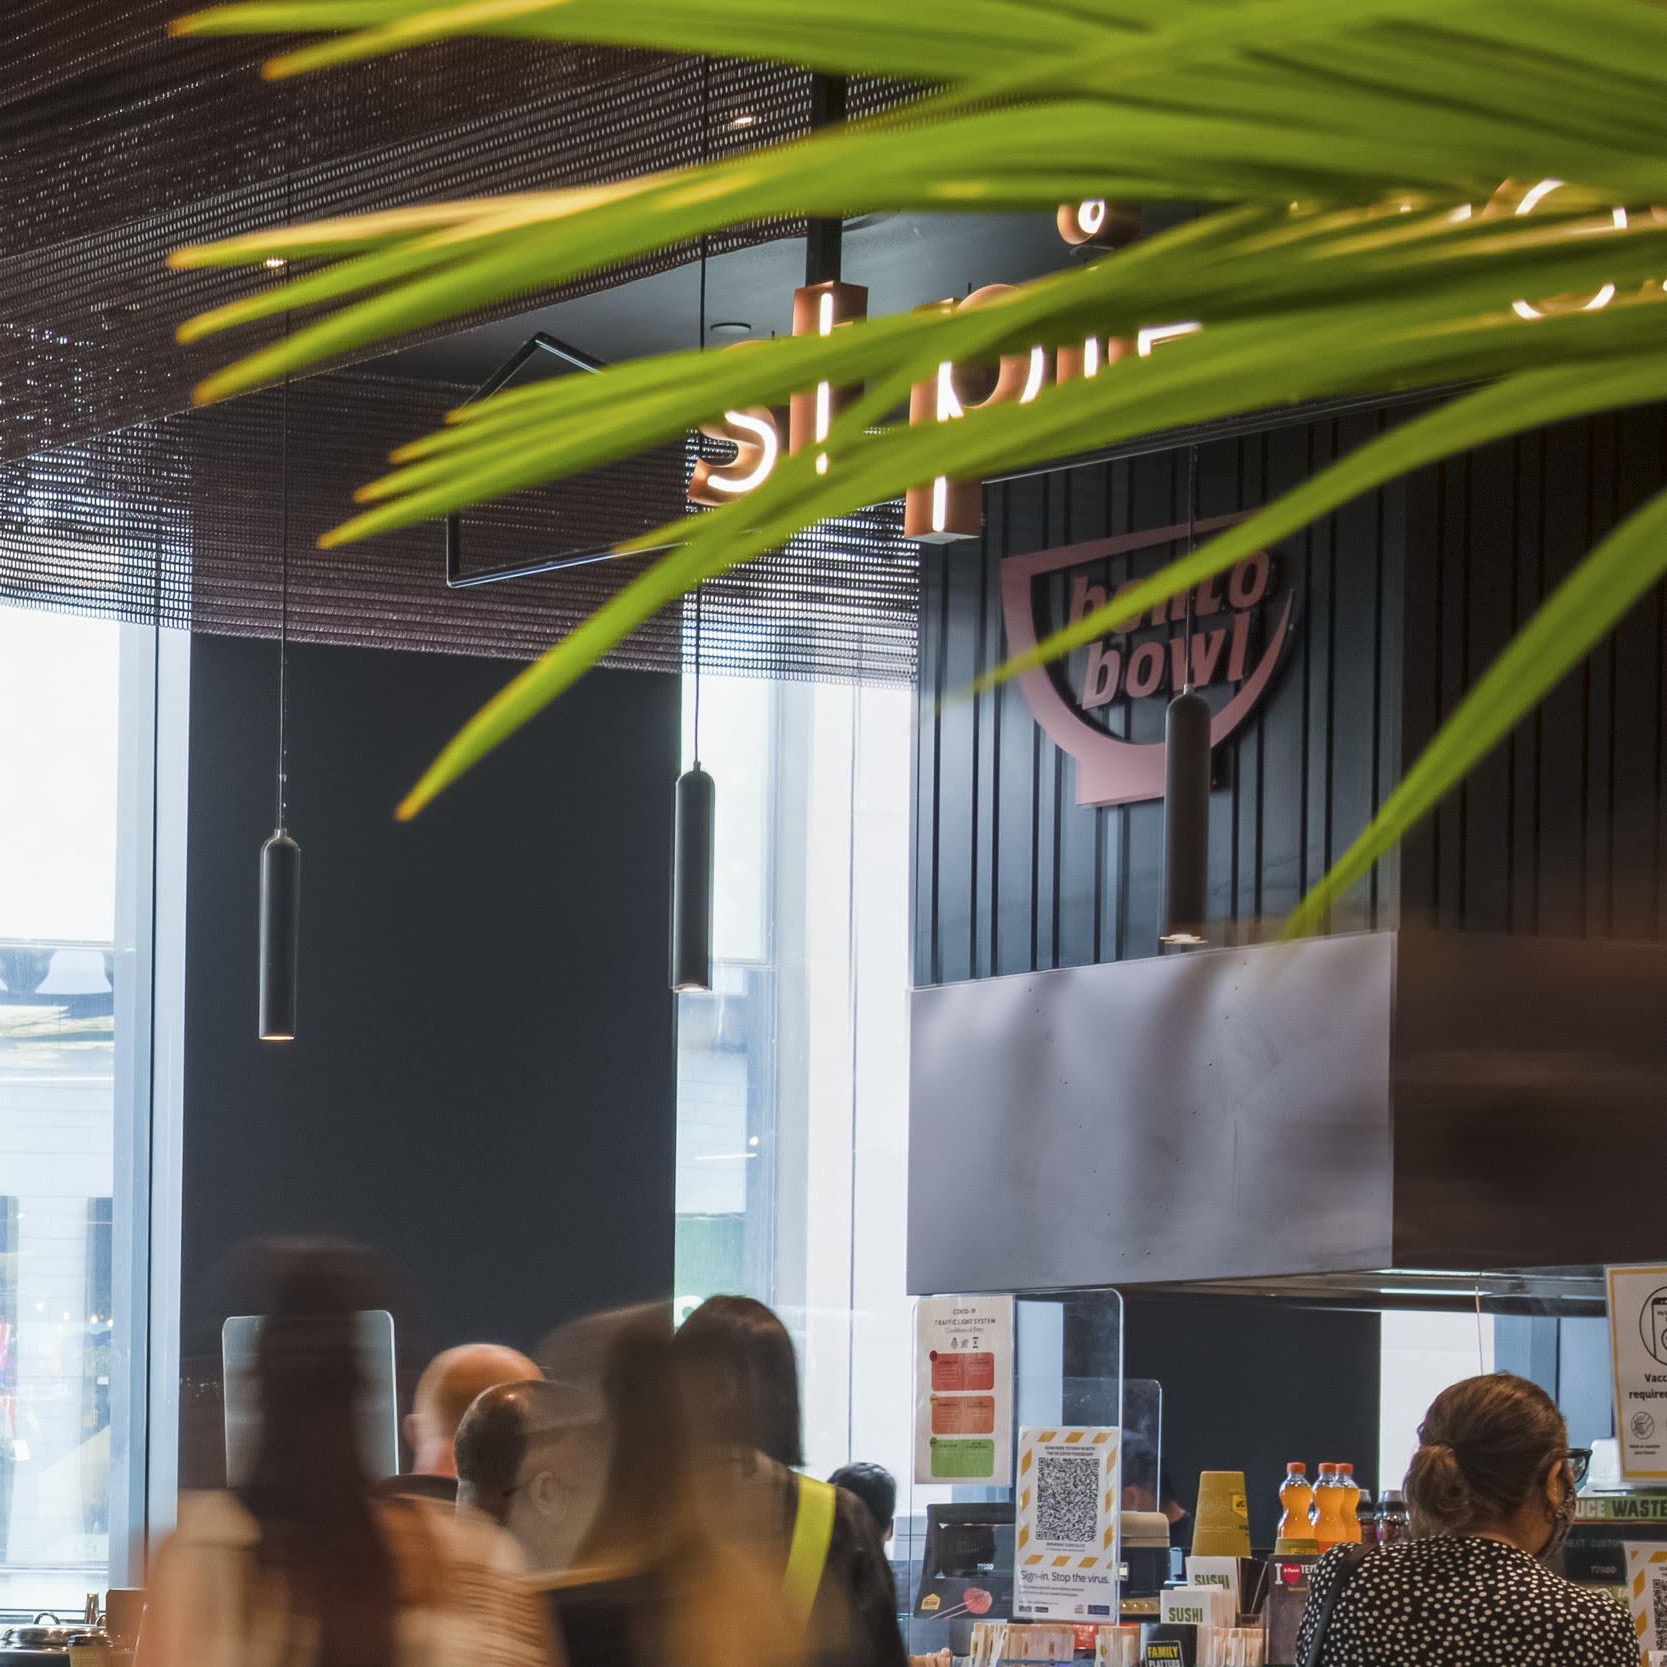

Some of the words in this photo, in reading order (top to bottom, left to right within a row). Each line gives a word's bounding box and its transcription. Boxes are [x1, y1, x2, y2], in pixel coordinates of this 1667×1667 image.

[1081, 611, 1251, 711] bowl
[1644, 1373, 1667, 1383] Vacc
[1575, 1499, 1606, 1517] UCE
[1612, 1499, 1667, 1517] WASTE
[1051, 1572, 1072, 1584] Stop
[1072, 1573, 1087, 1583] the
[1194, 1574, 1230, 1589] SUSHI
[1168, 1607, 1203, 1622] SUSHI
[1147, 1645, 1178, 1659] FAMILY
